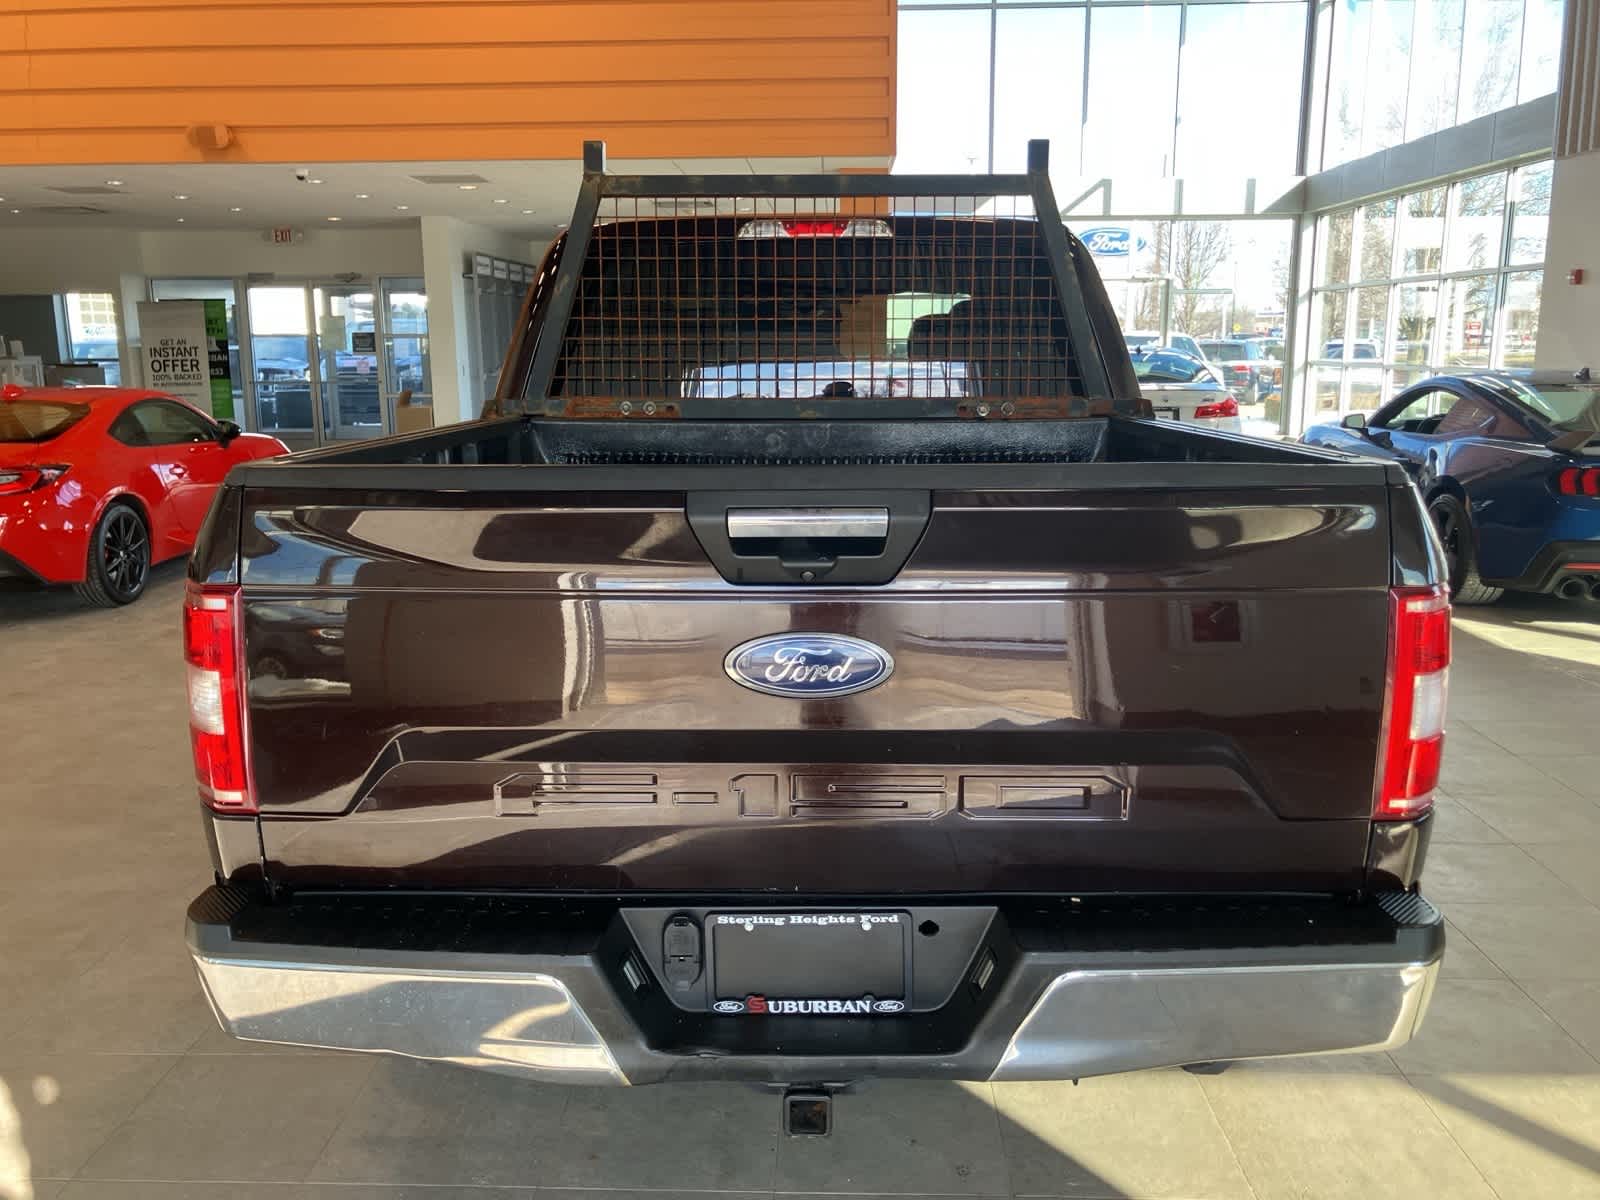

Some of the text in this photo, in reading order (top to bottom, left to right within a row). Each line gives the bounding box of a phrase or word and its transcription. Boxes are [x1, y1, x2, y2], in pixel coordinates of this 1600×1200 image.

[274, 229, 291, 243] EXIT
[160, 338, 187, 346] GET AN
[149, 346, 199, 358] INSTANT
[151, 359, 200, 373] OFFER
[174, 373, 202, 381] BACKED
[764, 646, 854, 683] Ford
[493, 772, 1132, 821] F-150
[717, 914, 900, 926] Sterling Heights Ford
[747, 996, 873, 1014] SUBURBAN
[877, 1001, 901, 1012] Ford
